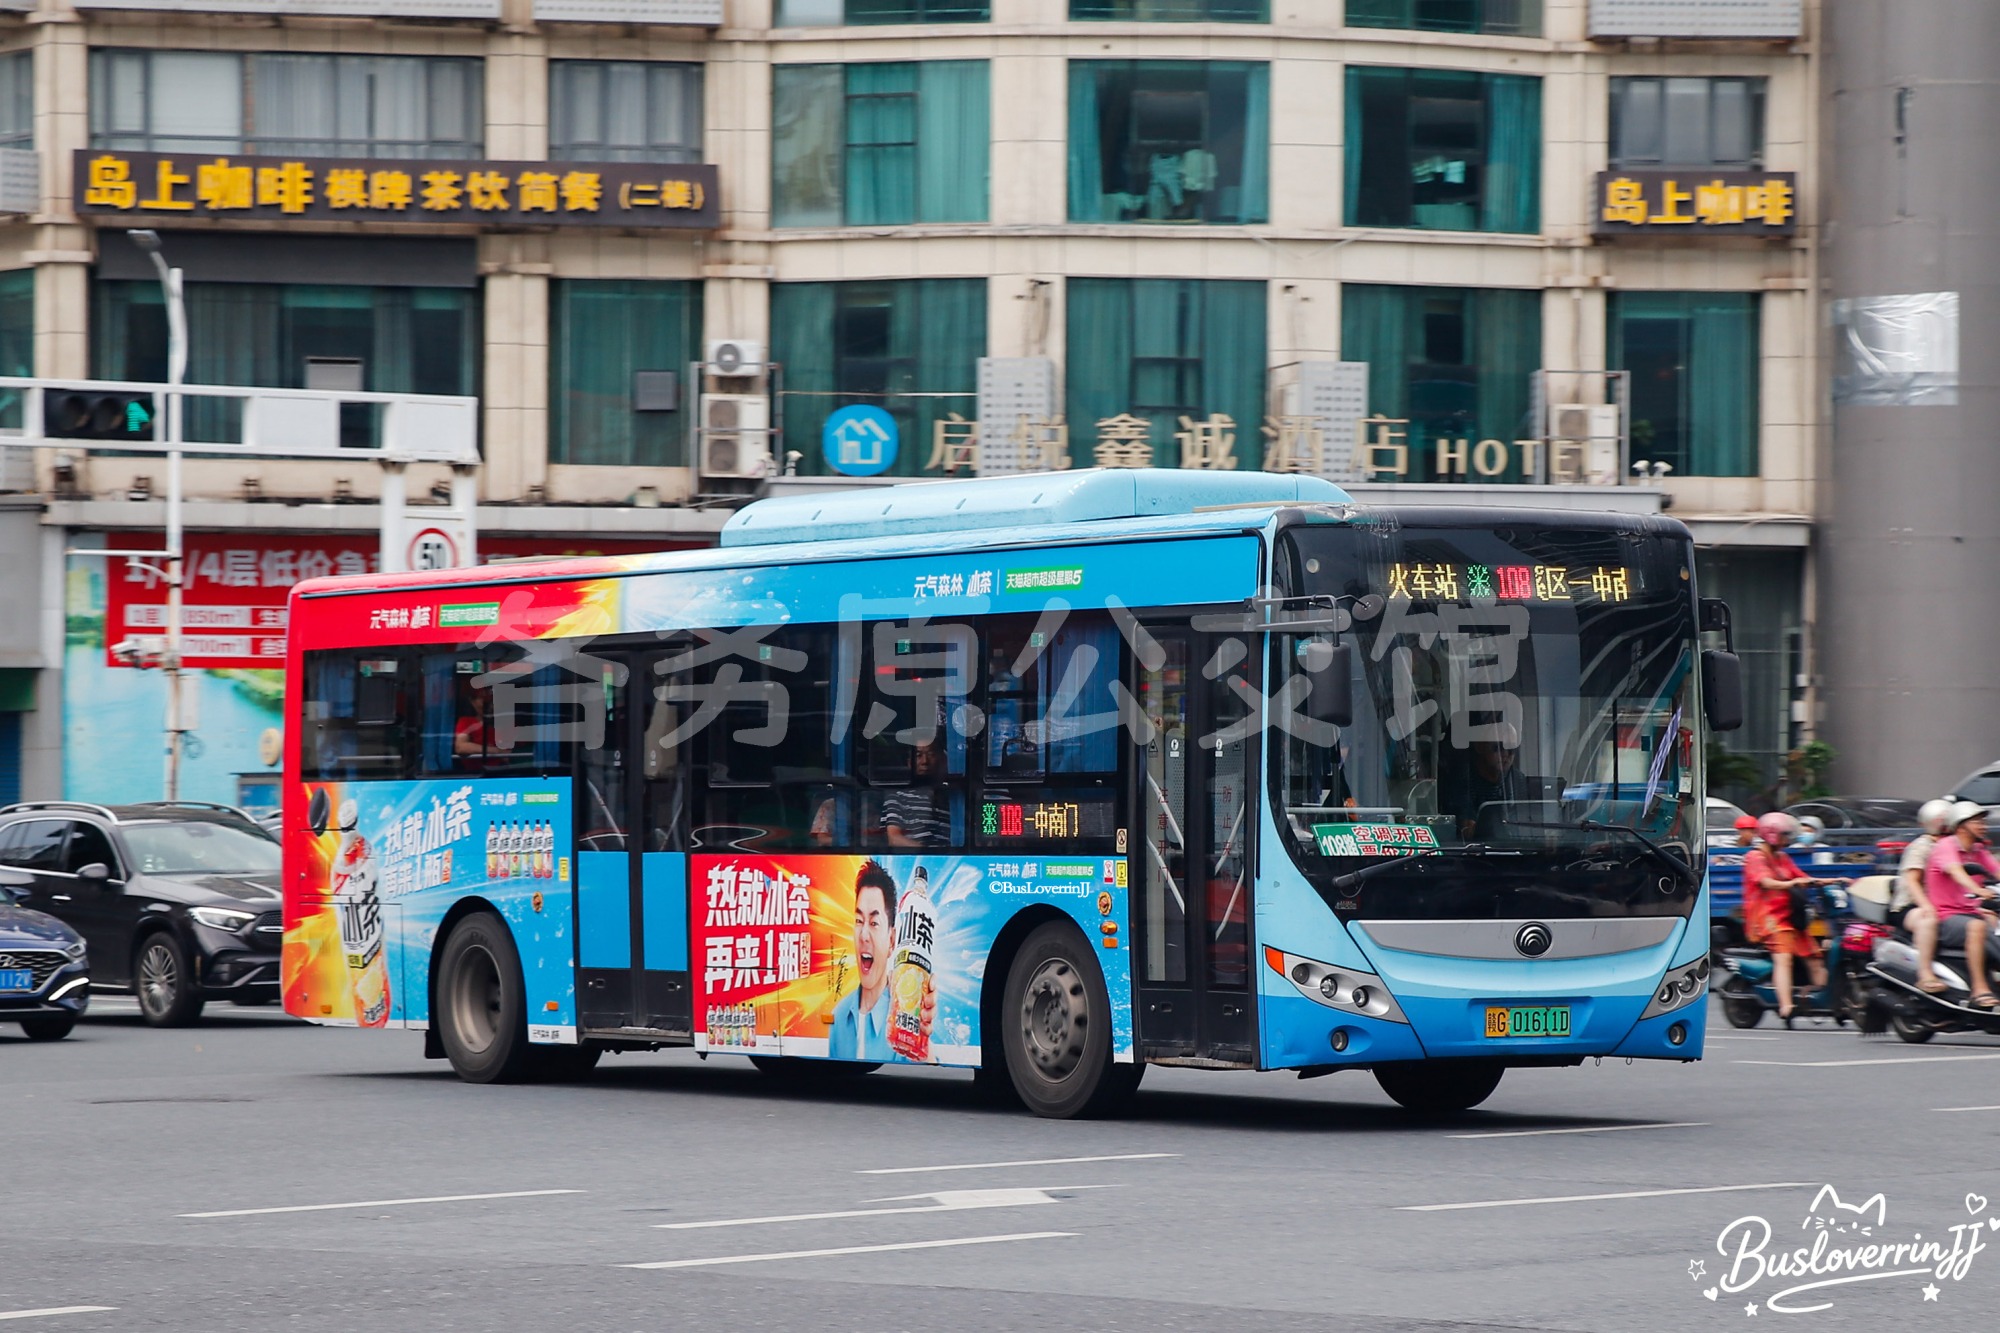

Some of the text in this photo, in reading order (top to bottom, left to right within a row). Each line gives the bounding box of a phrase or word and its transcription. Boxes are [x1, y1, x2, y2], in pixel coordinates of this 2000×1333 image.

[85, 155, 314, 213] 岛上咖啡
[1602, 177, 1794, 225] 岛上咖啡
[421, 542, 447, 570] 50
[913, 569, 1083, 598] 元气森林 冰茶 天猫超市超级星期5
[1388, 563, 1459, 600] 火车站
[1497, 566, 1532, 599] 108
[384, 786, 473, 867] 热就冰茶
[1000, 804, 1022, 835] 108
[1351, 826, 1434, 844] 空调开启
[704, 859, 811, 927] 热就冰茶
[704, 929, 800, 995] 再来1瓶
